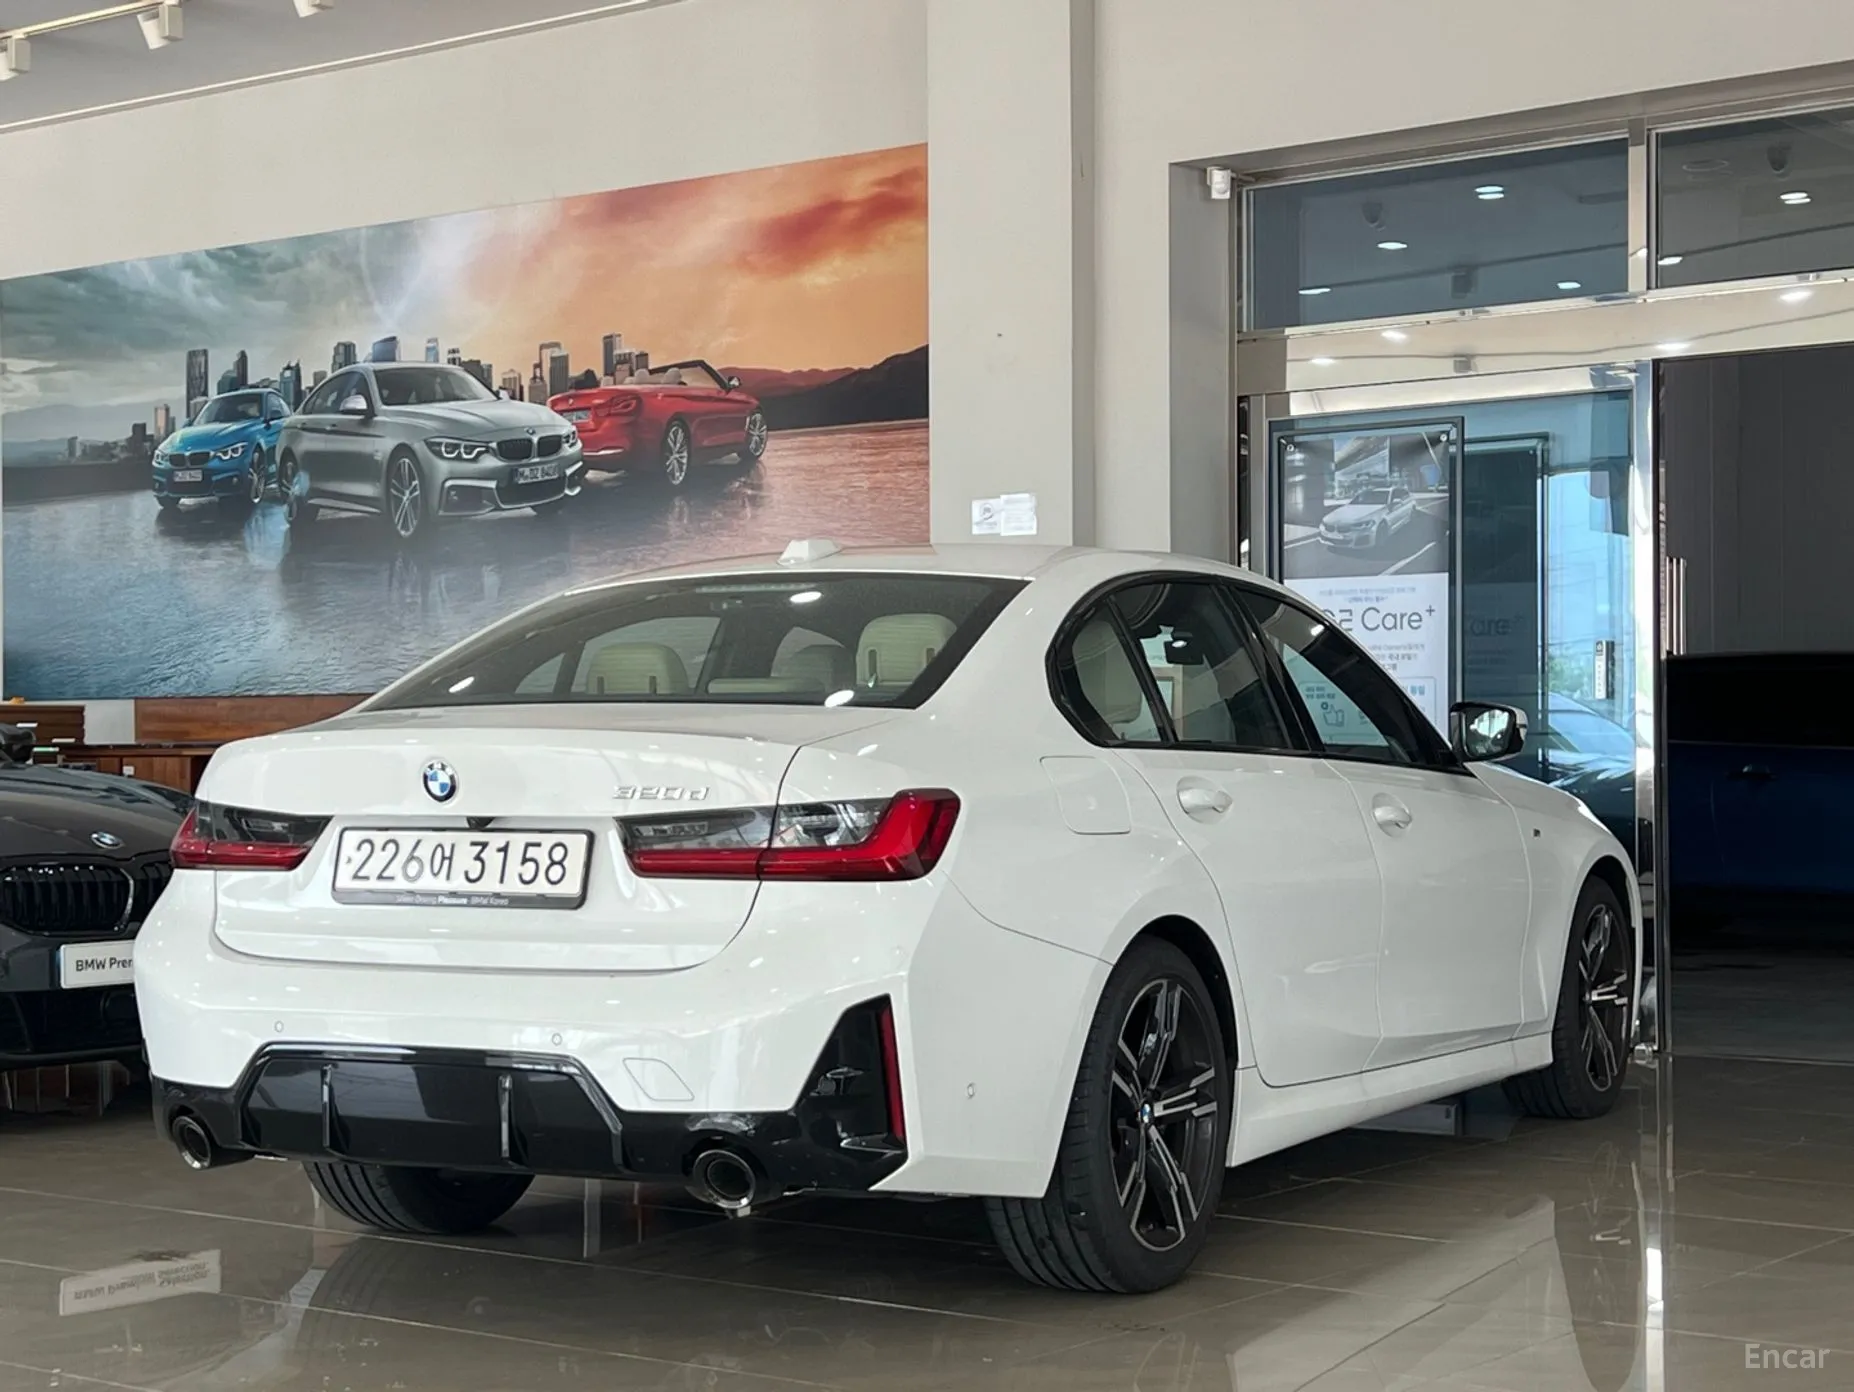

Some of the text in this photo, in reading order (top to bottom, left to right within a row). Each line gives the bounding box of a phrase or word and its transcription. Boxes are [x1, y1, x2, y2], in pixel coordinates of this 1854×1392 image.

[612, 786, 711, 801] 320d
[352, 838, 569, 886] 226어 3158
[75, 958, 107, 972] BMW
